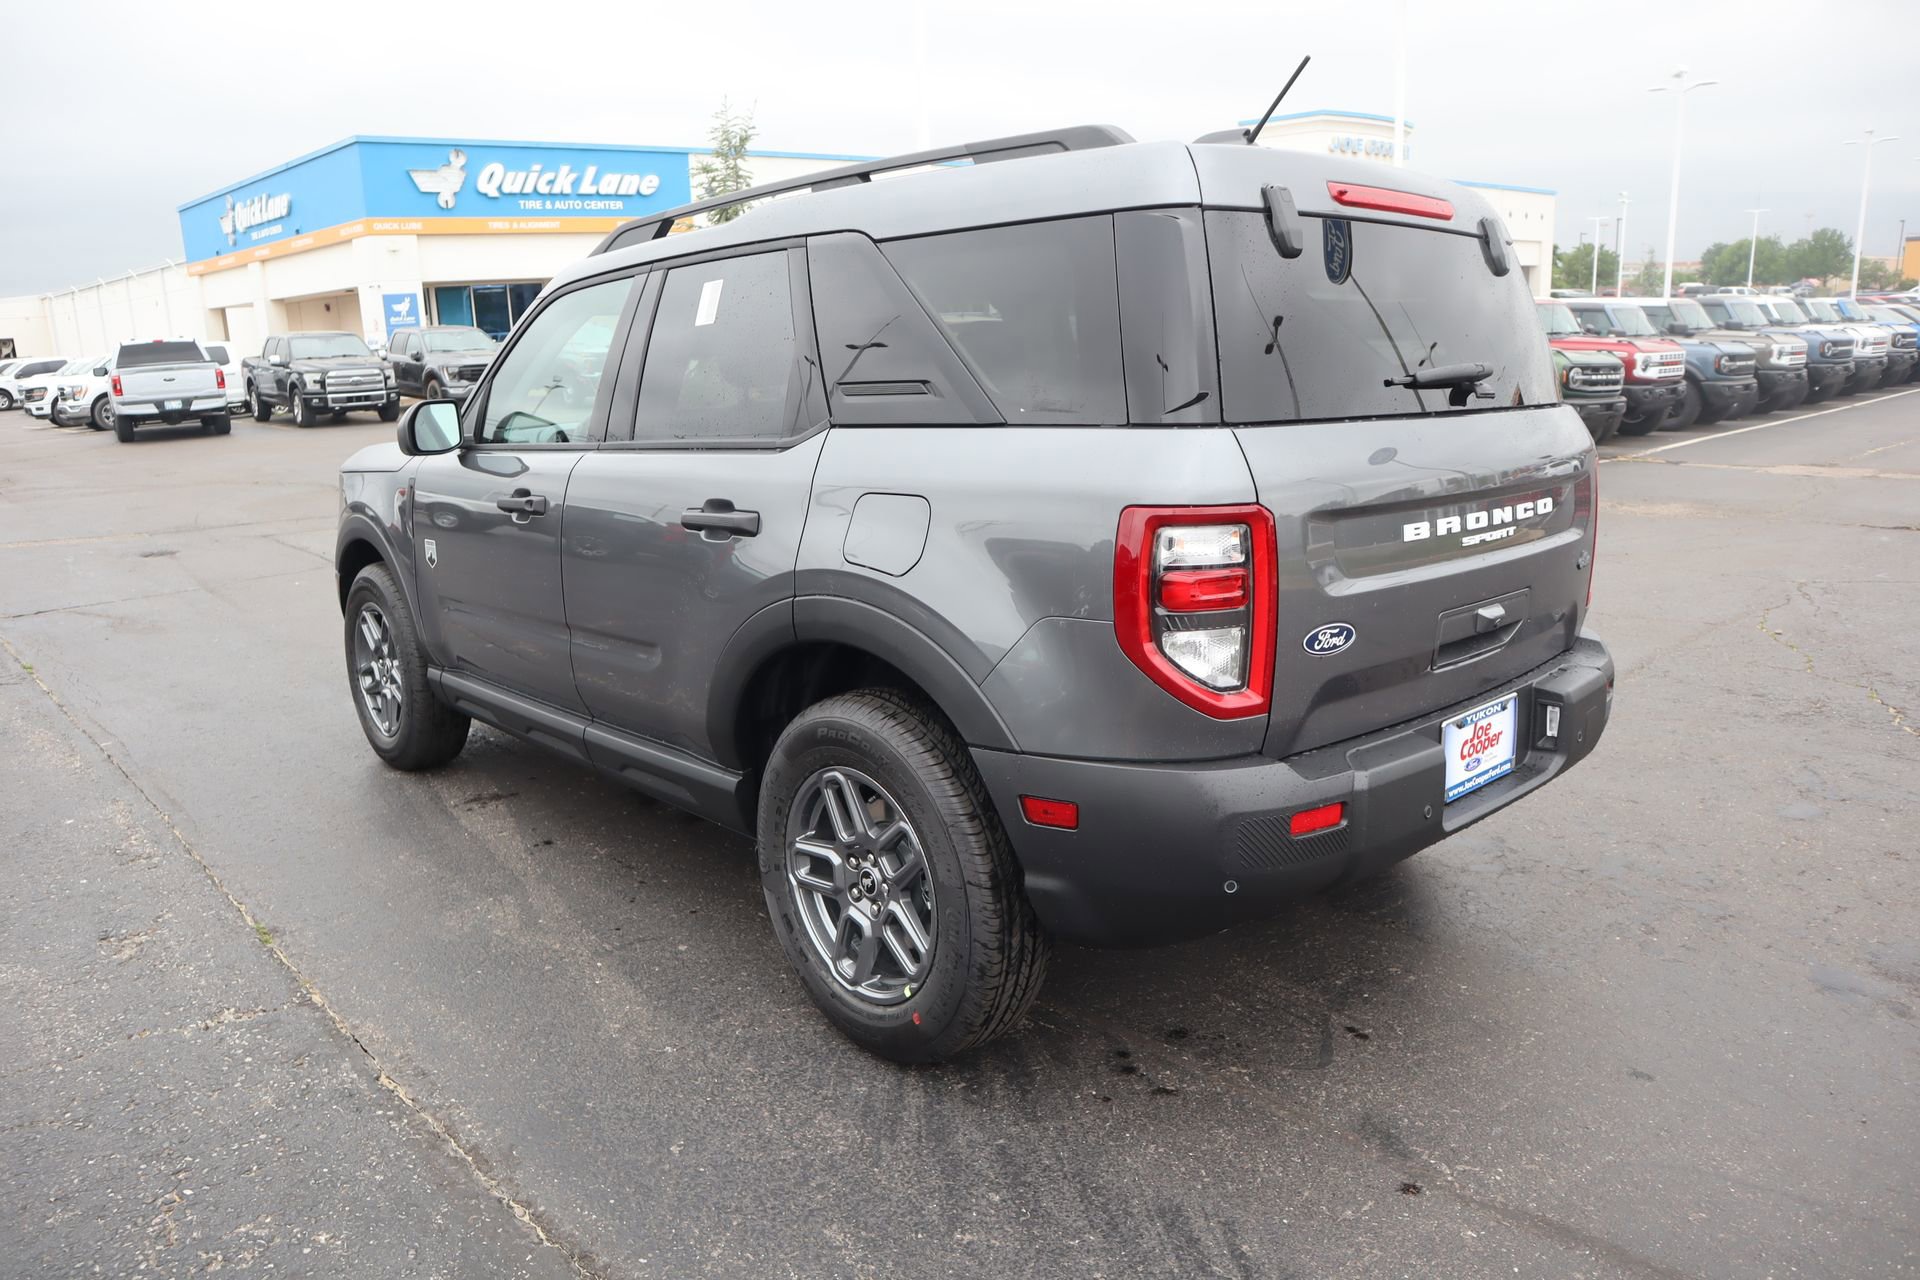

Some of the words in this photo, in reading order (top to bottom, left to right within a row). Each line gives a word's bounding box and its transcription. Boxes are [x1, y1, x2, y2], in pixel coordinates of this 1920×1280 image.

[476, 162, 579, 198] Quick
[576, 165, 660, 196] Lane
[235, 195, 262, 233] Quick
[261, 192, 290, 221] Lane
[518, 200, 543, 209] TIRE
[545, 201, 553, 209] &
[554, 200, 582, 210] AUTO
[583, 201, 624, 210] CENTER
[373, 222, 399, 230] QUICK
[400, 222, 422, 230] LUBE
[1403, 497, 1553, 542] BRONCO
[1461, 526, 1517, 547] SPORT
[1313, 627, 1348, 651] Ford
[1465, 703, 1502, 724] YUKON
[1469, 721, 1492, 743] Joe
[1460, 730, 1503, 761] Cooper
